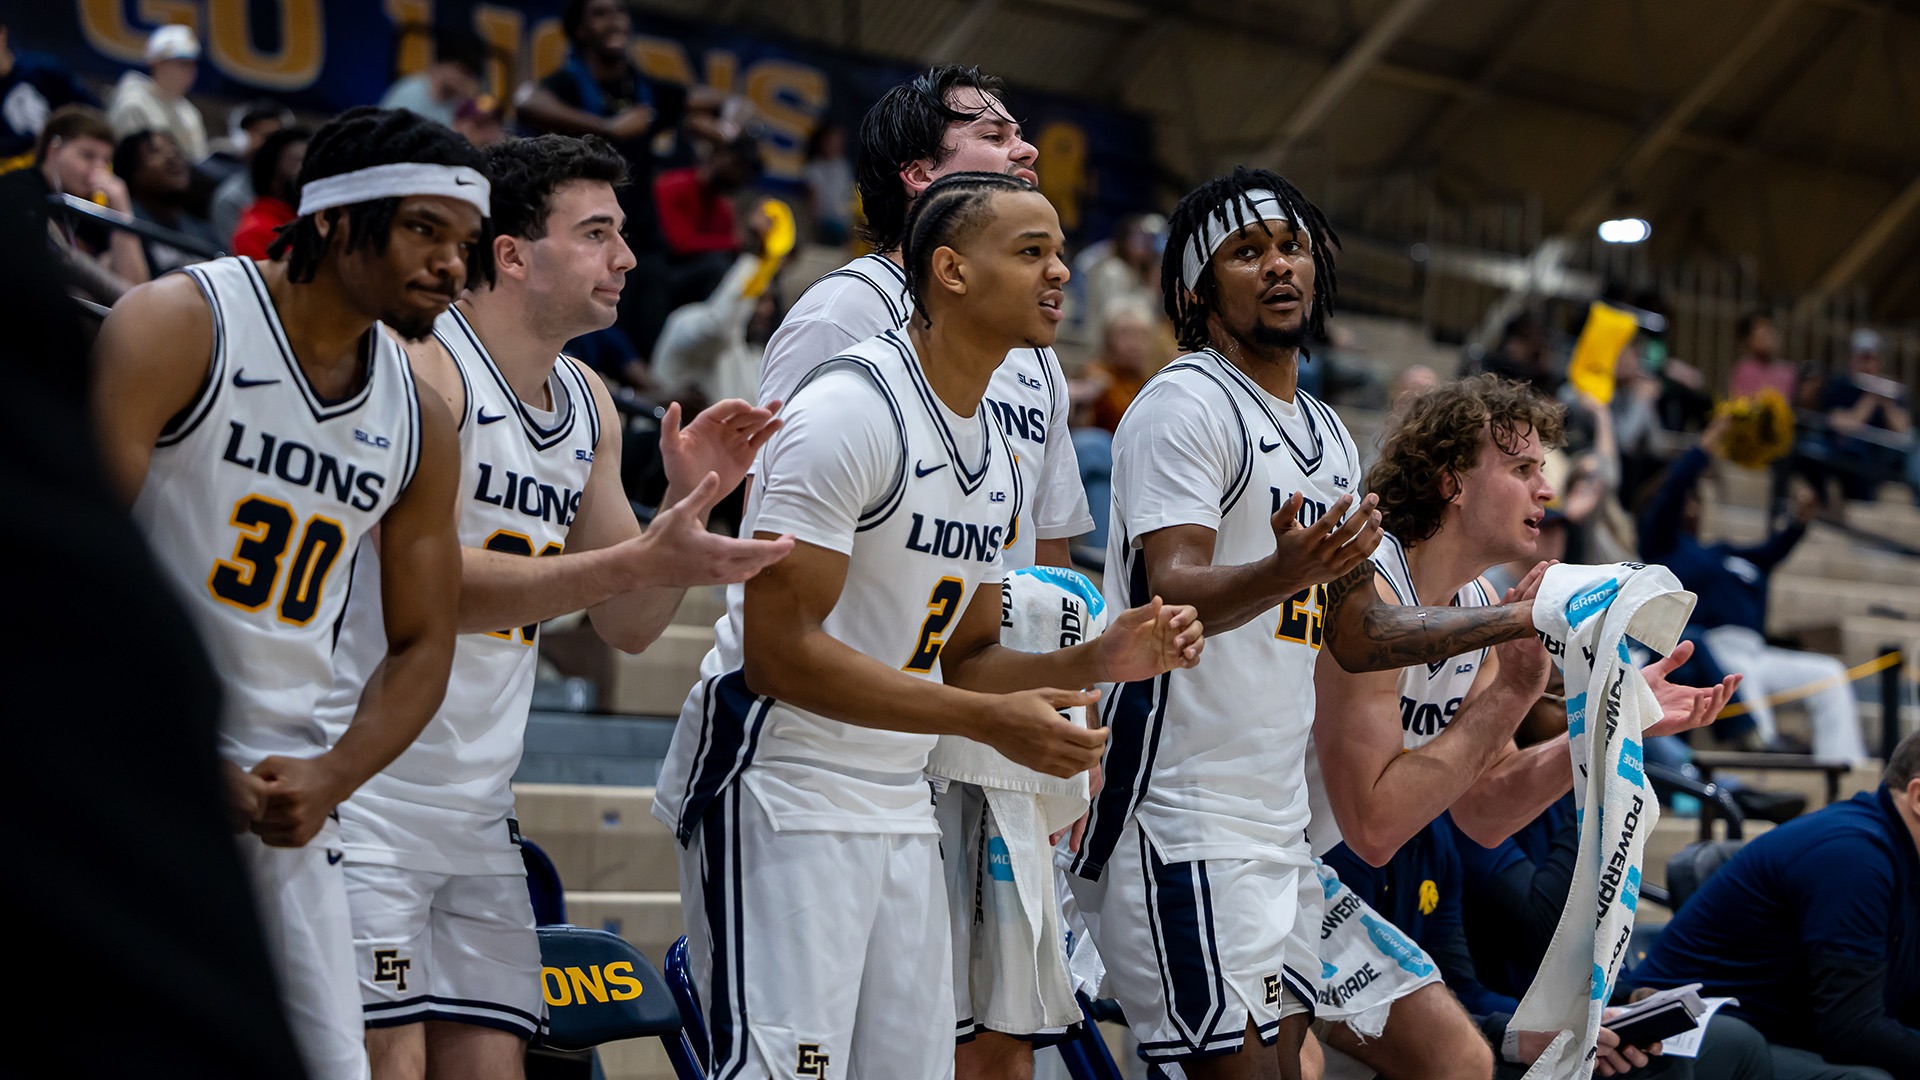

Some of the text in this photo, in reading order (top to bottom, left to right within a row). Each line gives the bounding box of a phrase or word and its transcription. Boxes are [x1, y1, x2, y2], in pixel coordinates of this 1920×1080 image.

[80, 0, 324, 91] GO
[223, 419, 387, 513] LIONS
[474, 462, 583, 527] LIONS
[206, 492, 346, 628] 30
[905, 512, 1003, 563] LIONS
[901, 575, 965, 674] 2
[372, 949, 411, 993] ET
[796, 1042, 830, 1080] ET
